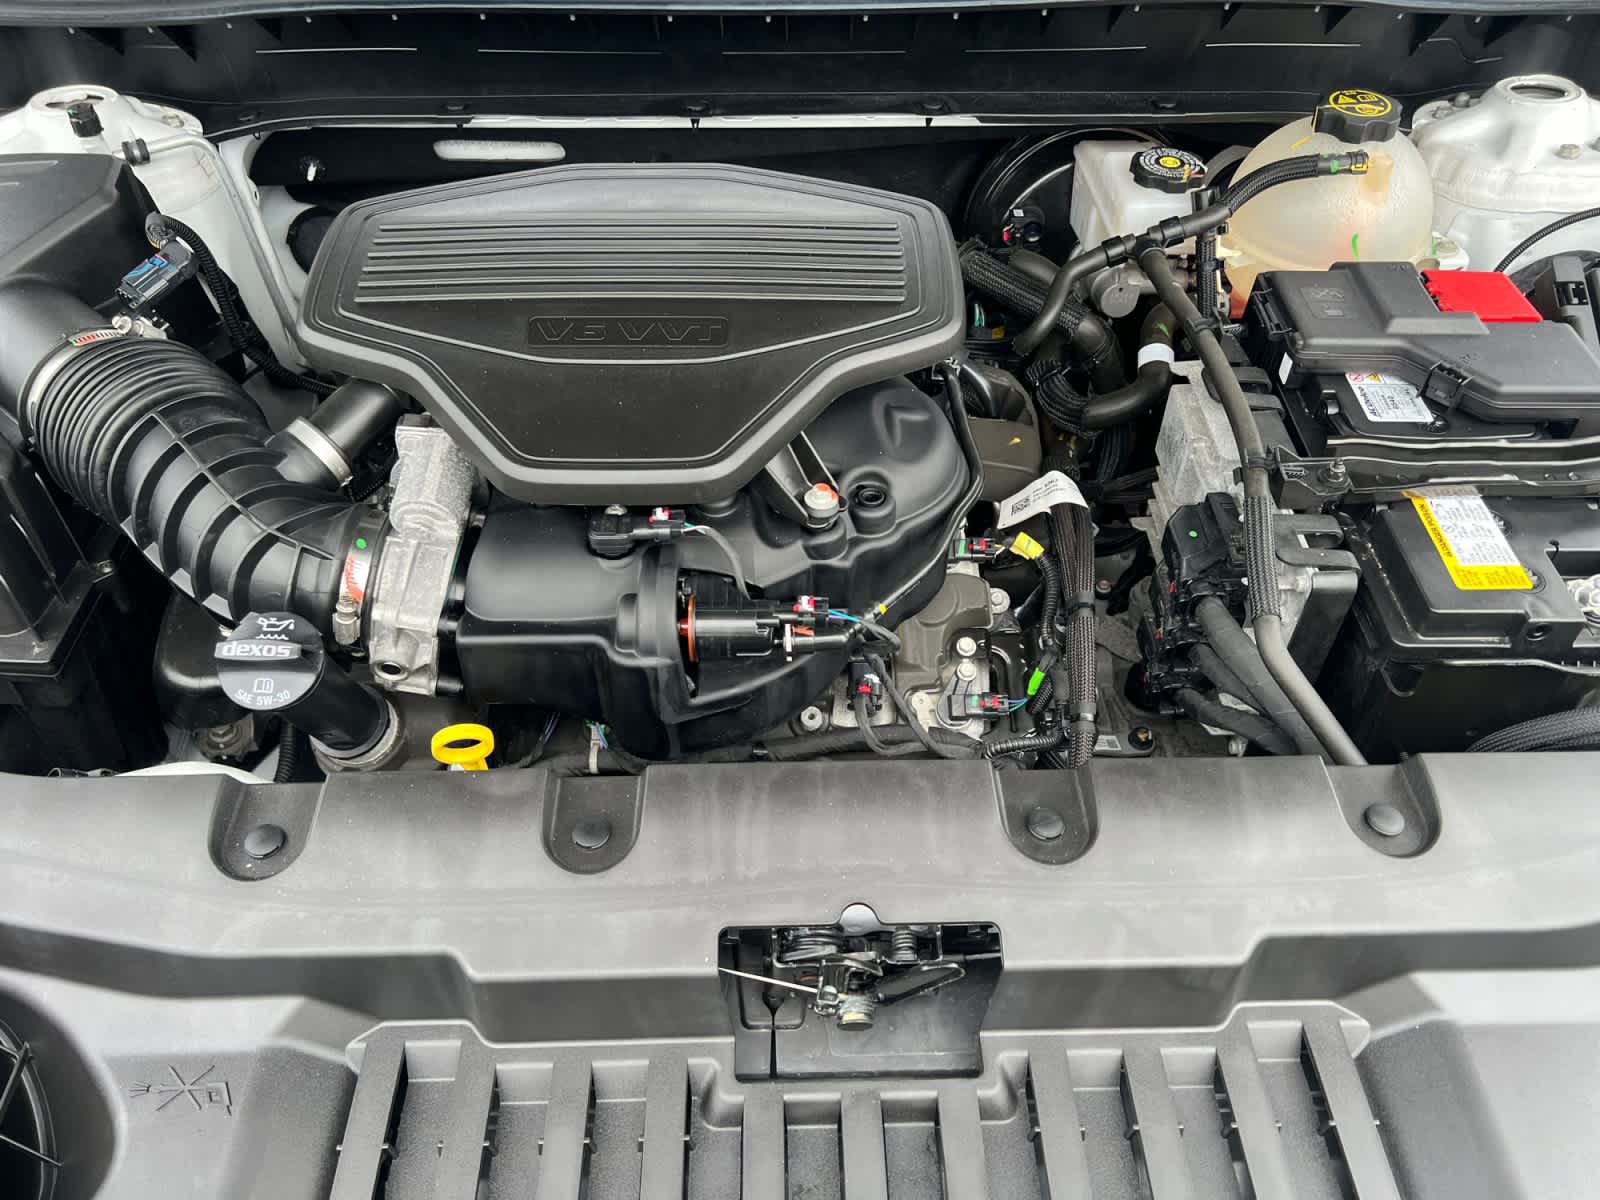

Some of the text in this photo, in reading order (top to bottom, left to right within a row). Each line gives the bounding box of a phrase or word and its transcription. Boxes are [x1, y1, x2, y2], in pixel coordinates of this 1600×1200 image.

[535, 319, 723, 342] V6 VVT
[222, 641, 293, 657] dexos
[234, 688, 289, 706] SAE 5W-30
